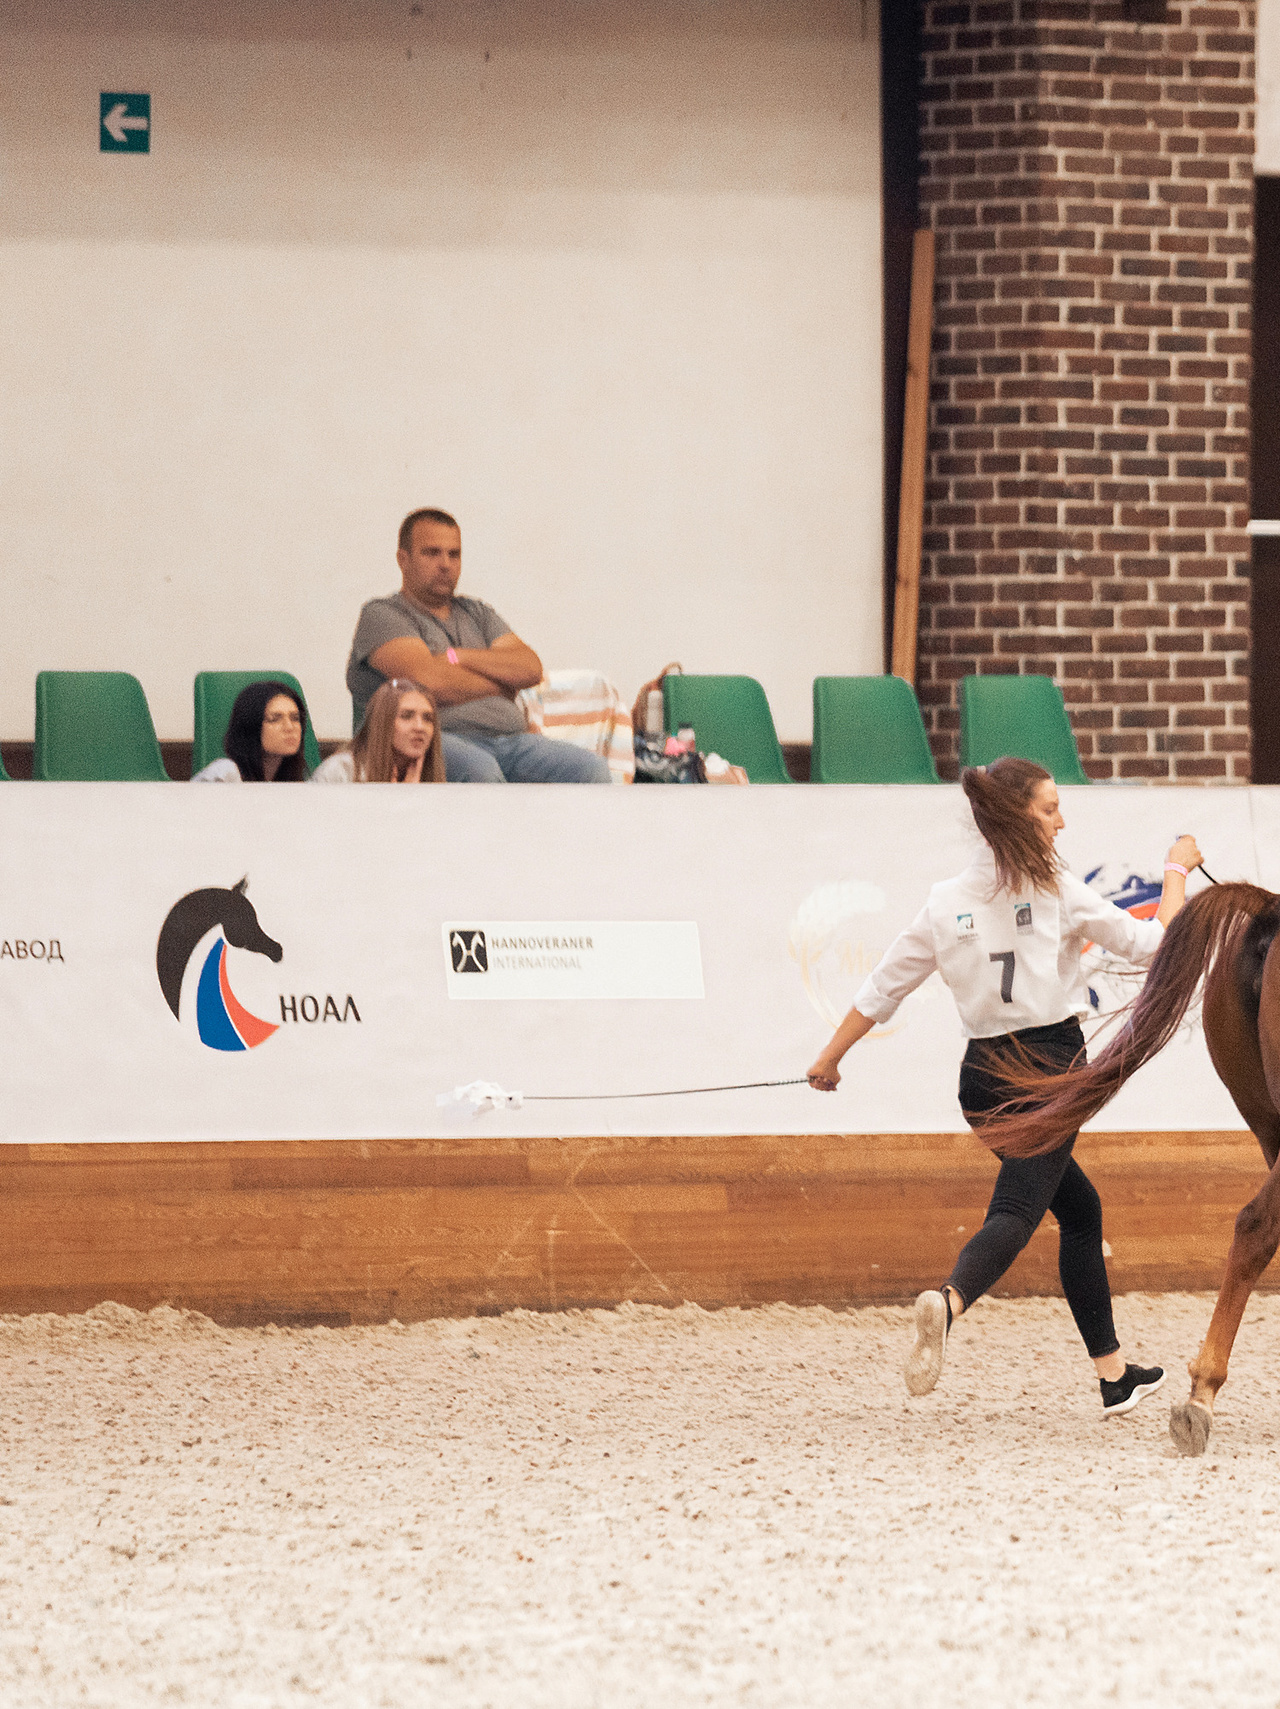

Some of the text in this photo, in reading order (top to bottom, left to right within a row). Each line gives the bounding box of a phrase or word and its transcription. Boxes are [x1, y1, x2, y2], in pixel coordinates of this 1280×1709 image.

[490, 935, 595, 951] HANNOVERANER
[491, 954, 583, 971] INTERNATIONAL
[988, 950, 1016, 1004] 7
[279, 994, 362, 1024] НОАЛ
